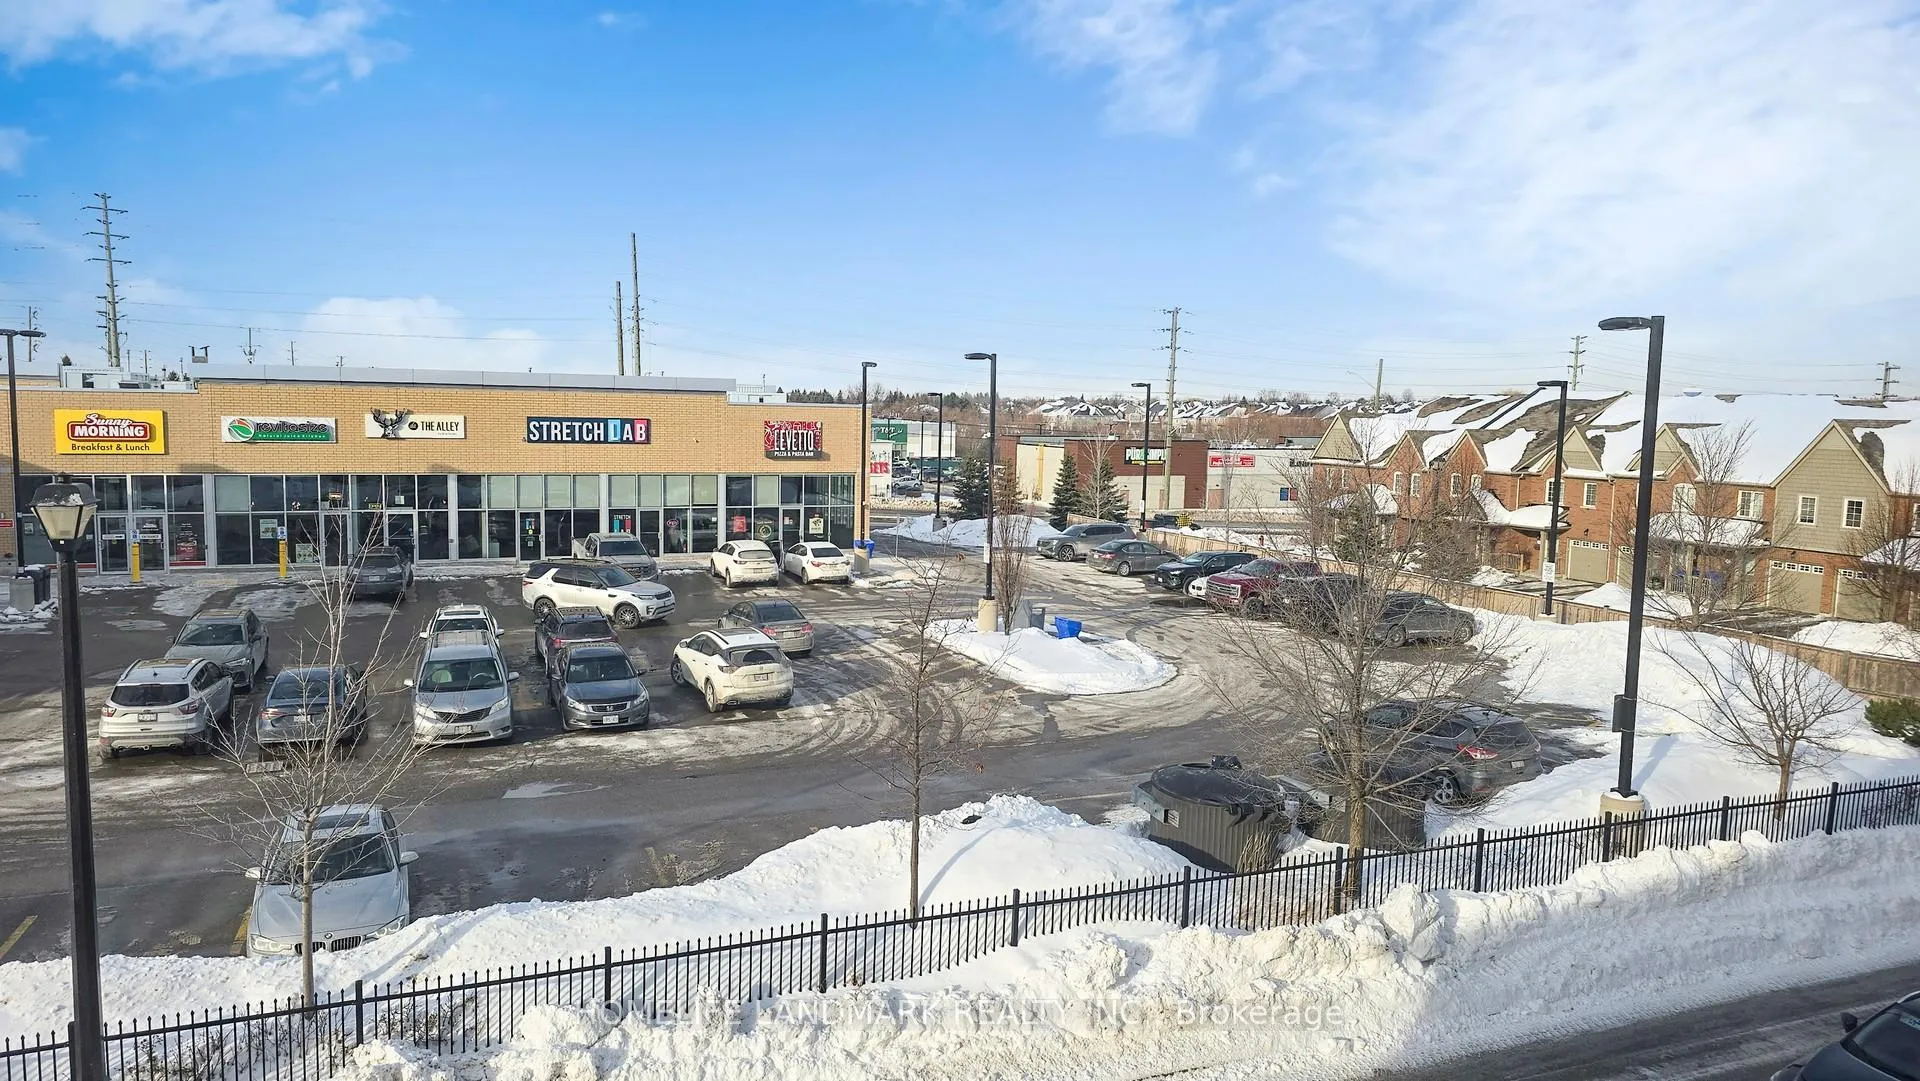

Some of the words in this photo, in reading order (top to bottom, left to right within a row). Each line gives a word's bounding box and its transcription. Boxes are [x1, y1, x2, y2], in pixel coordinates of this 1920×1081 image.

[85, 413, 132, 428] Sunny
[256, 420, 328, 432] revitasize
[421, 421, 435, 431] THE
[436, 421, 459, 431] ALLEY
[529, 420, 604, 441] STRETCH
[774, 429, 814, 450] LEVETTO
[71, 443, 113, 451] Breakfast
[115, 443, 123, 451] &
[125, 443, 150, 451] Lunch
